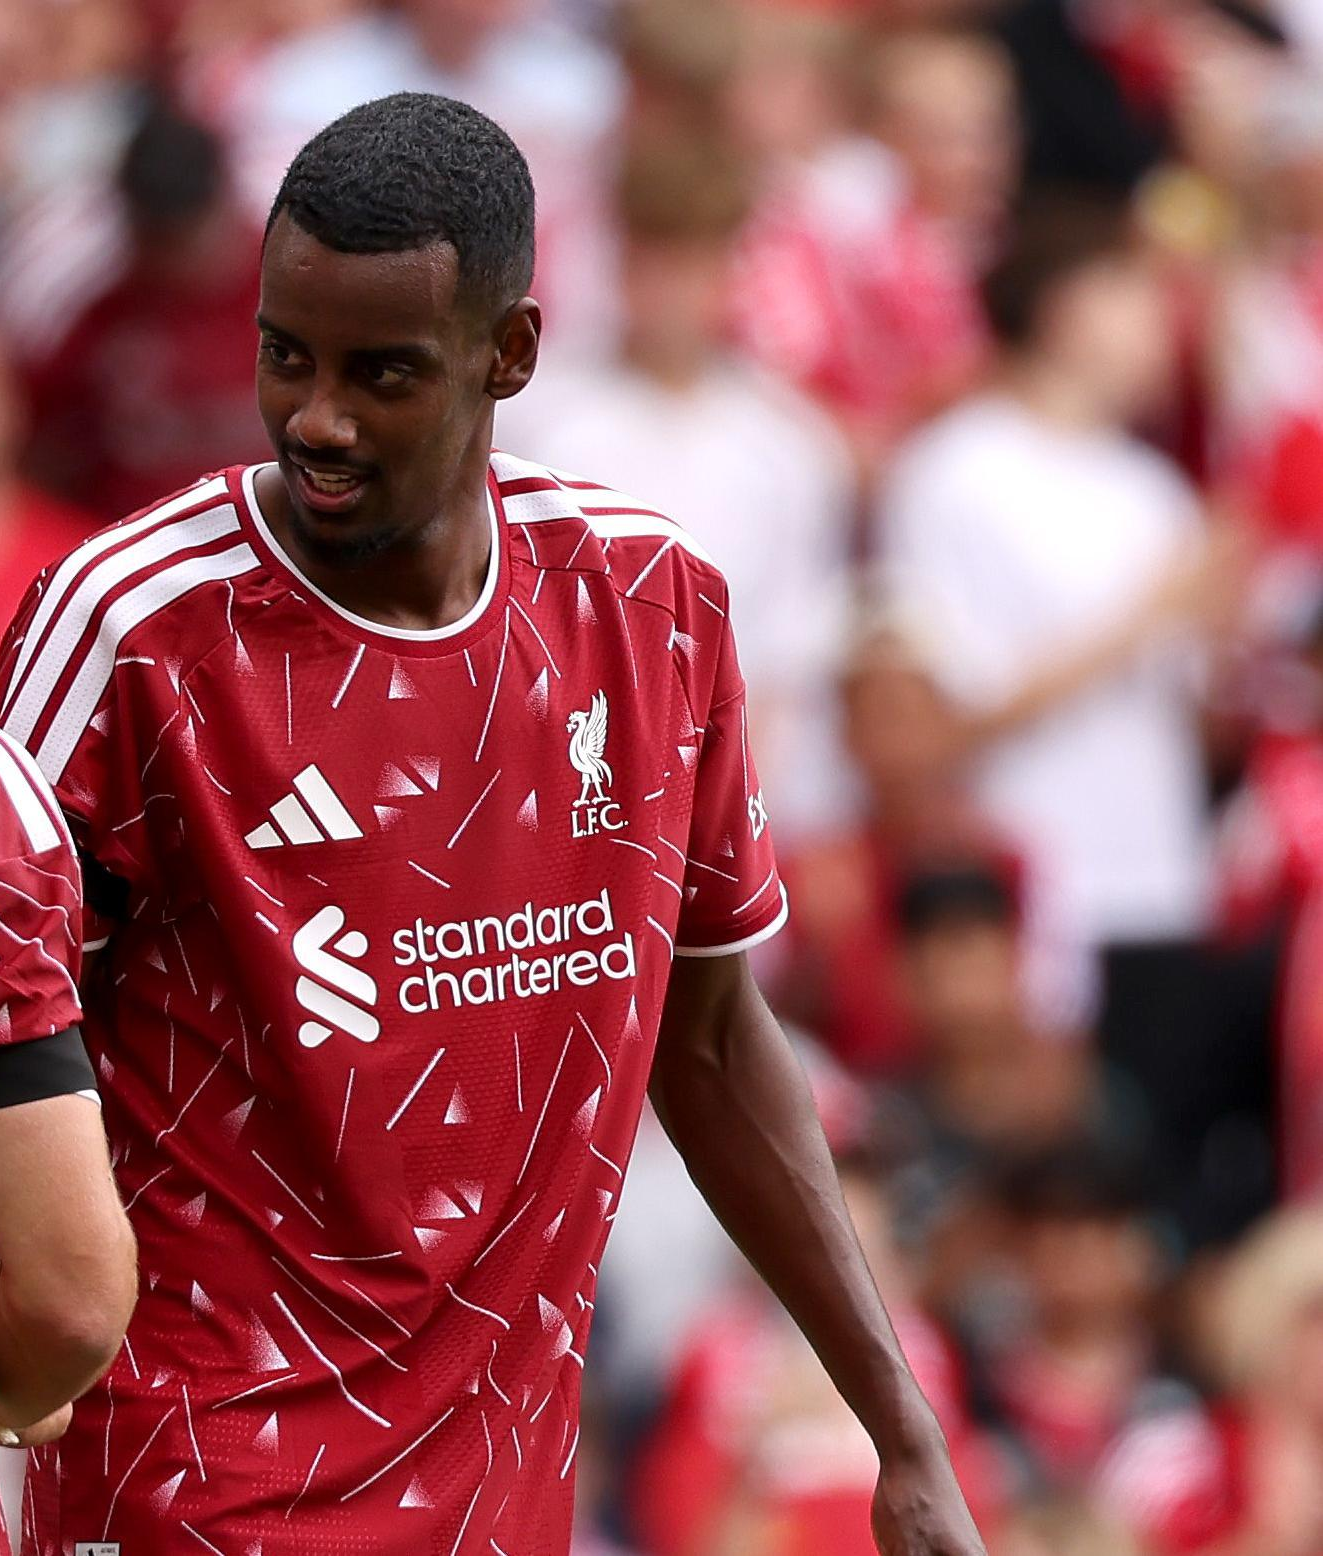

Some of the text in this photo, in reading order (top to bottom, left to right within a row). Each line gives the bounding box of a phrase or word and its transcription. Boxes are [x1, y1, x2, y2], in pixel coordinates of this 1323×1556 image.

[571, 803, 629, 838] L.F.C.
[392, 887, 614, 966] standard
[399, 931, 636, 1013] chartered
